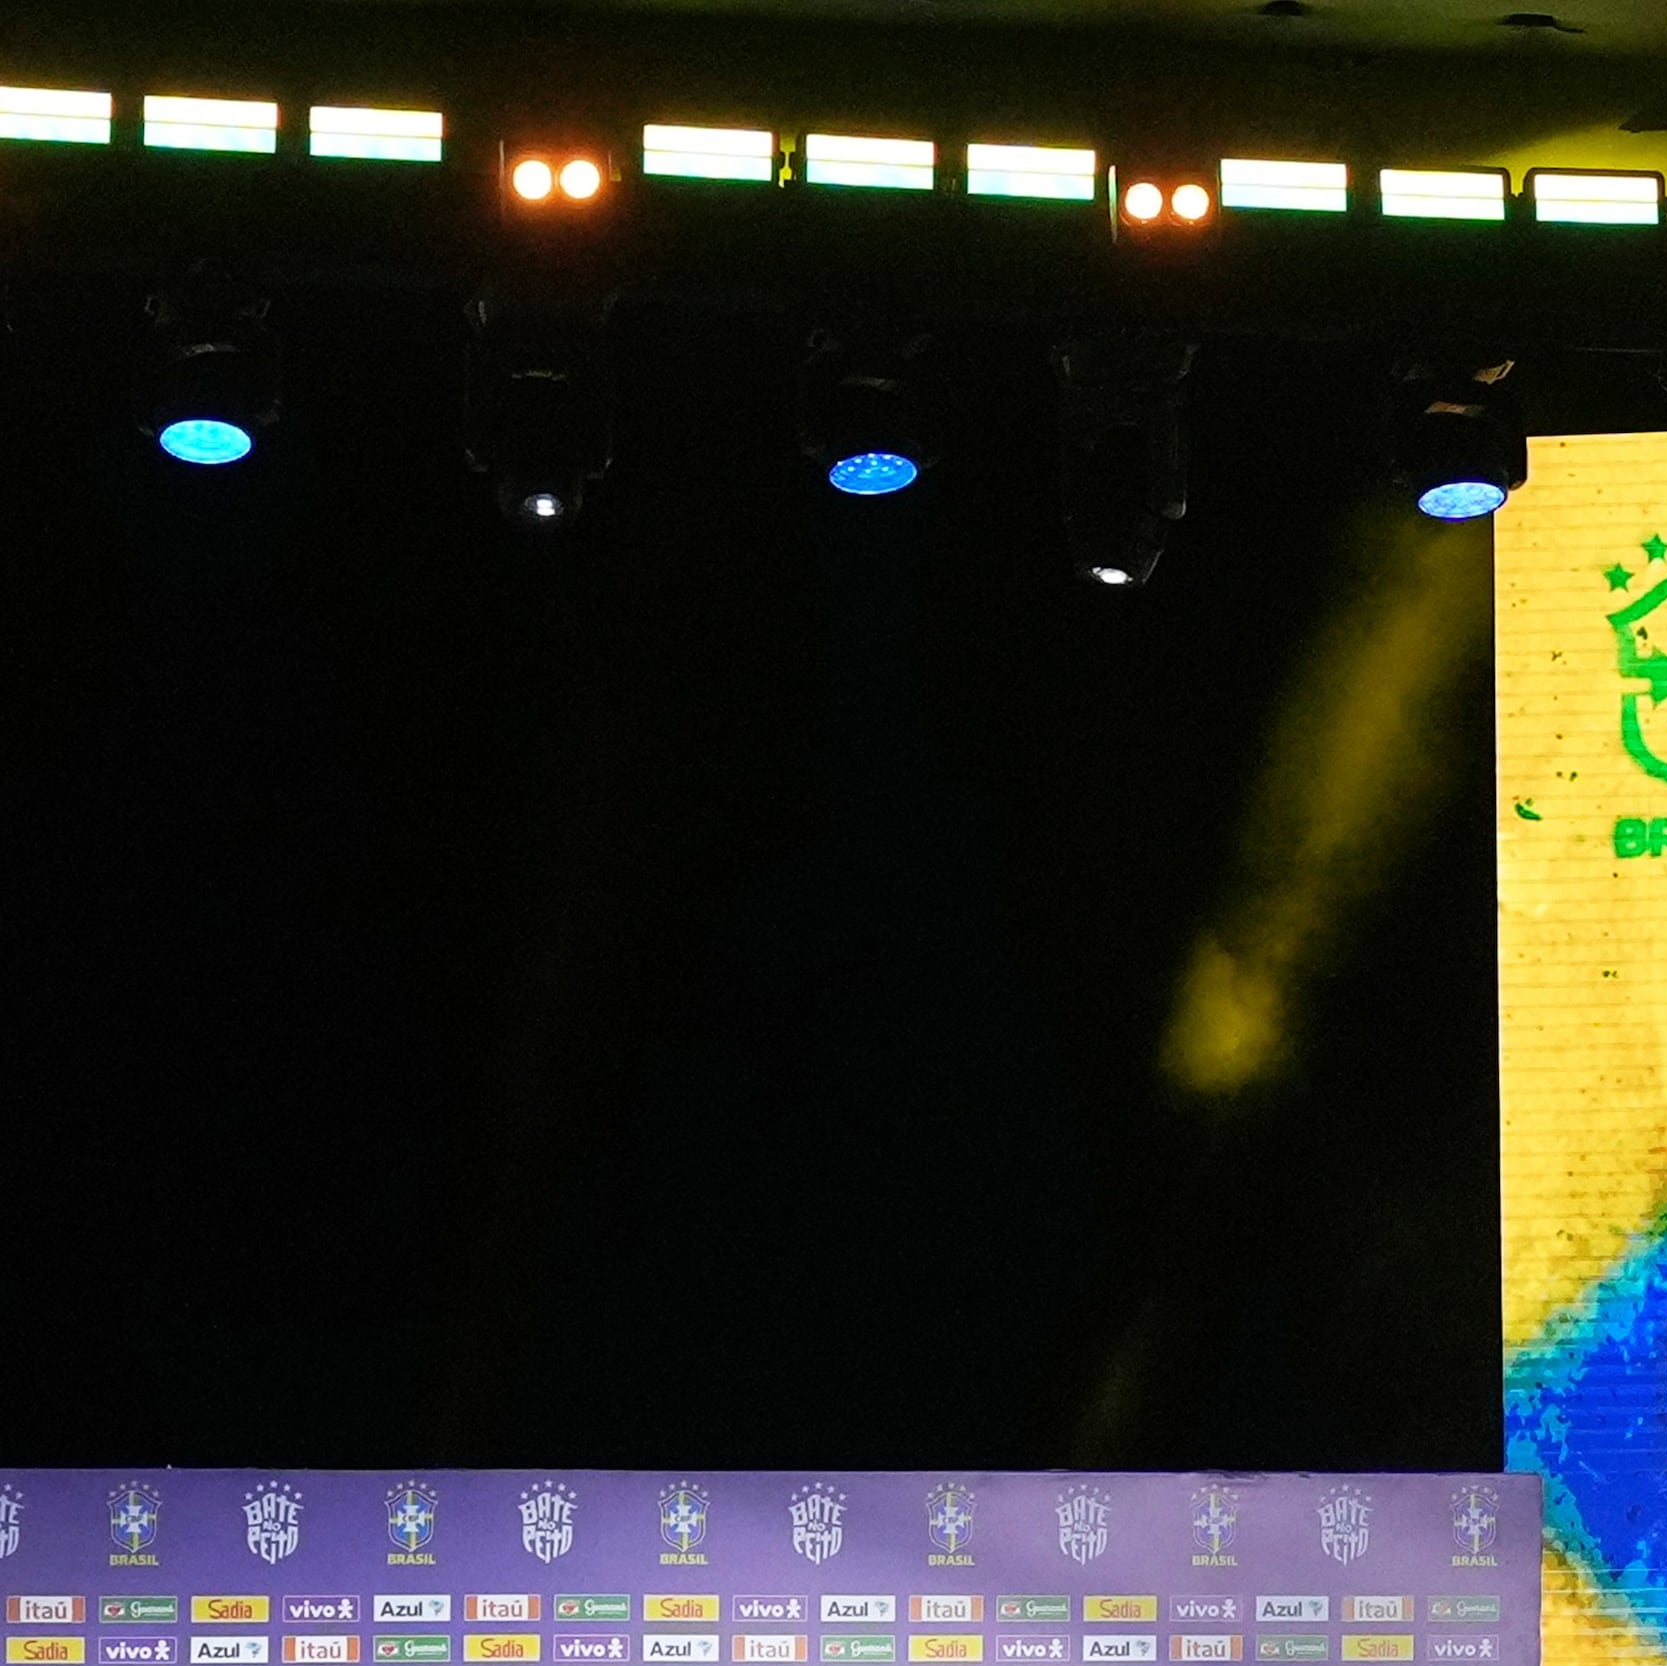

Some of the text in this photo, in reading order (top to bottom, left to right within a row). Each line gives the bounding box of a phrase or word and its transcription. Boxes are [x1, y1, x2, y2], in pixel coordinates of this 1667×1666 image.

[242, 1493, 303, 1525] BATE
[518, 1493, 578, 1525] BATE
[788, 1494, 848, 1526] BATE
[1055, 1495, 1112, 1526] BATE
[1316, 1496, 1374, 1526] BATE
[110, 1554, 159, 1566] BRASIL
[387, 1553, 436, 1565] BRASIL
[660, 1553, 708, 1565] BRASIL
[928, 1555, 975, 1566] BRASIL
[1191, 1555, 1238, 1566] BRASIL
[1451, 1556, 1498, 1567] BRASIL
[26, 1601, 66, 1619] itaú
[206, 1599, 251, 1618] Sadia
[290, 1600, 335, 1617] vivo
[381, 1602, 422, 1616] Azul
[483, 1600, 522, 1617] itaú
[658, 1598, 702, 1617] Sadia
[740, 1600, 784, 1617] vivo
[828, 1602, 868, 1616] Azul
[927, 1600, 965, 1617] itaú
[1098, 1599, 1140, 1617] Sadia
[1177, 1601, 1219, 1616] vivo
[1263, 1601, 1302, 1616] Azul
[1359, 1601, 1397, 1618] itaú
[22, 1640, 67, 1660] Sadia
[106, 1642, 152, 1659] vivo
[198, 1643, 239, 1658] Azul
[301, 1641, 341, 1658] itaú
[479, 1639, 523, 1657] Sadia
[561, 1640, 605, 1657] vivo
[651, 1642, 691, 1656] Azul
[751, 1640, 789, 1657] itaú
[924, 1639, 967, 1657] Sadia
[1003, 1640, 1046, 1657] vivo
[1090, 1642, 1129, 1656] Azul
[1187, 1640, 1225, 1657] itaú
[1357, 1638, 1398, 1658] Sadia
[1435, 1640, 1476, 1656] vivo
